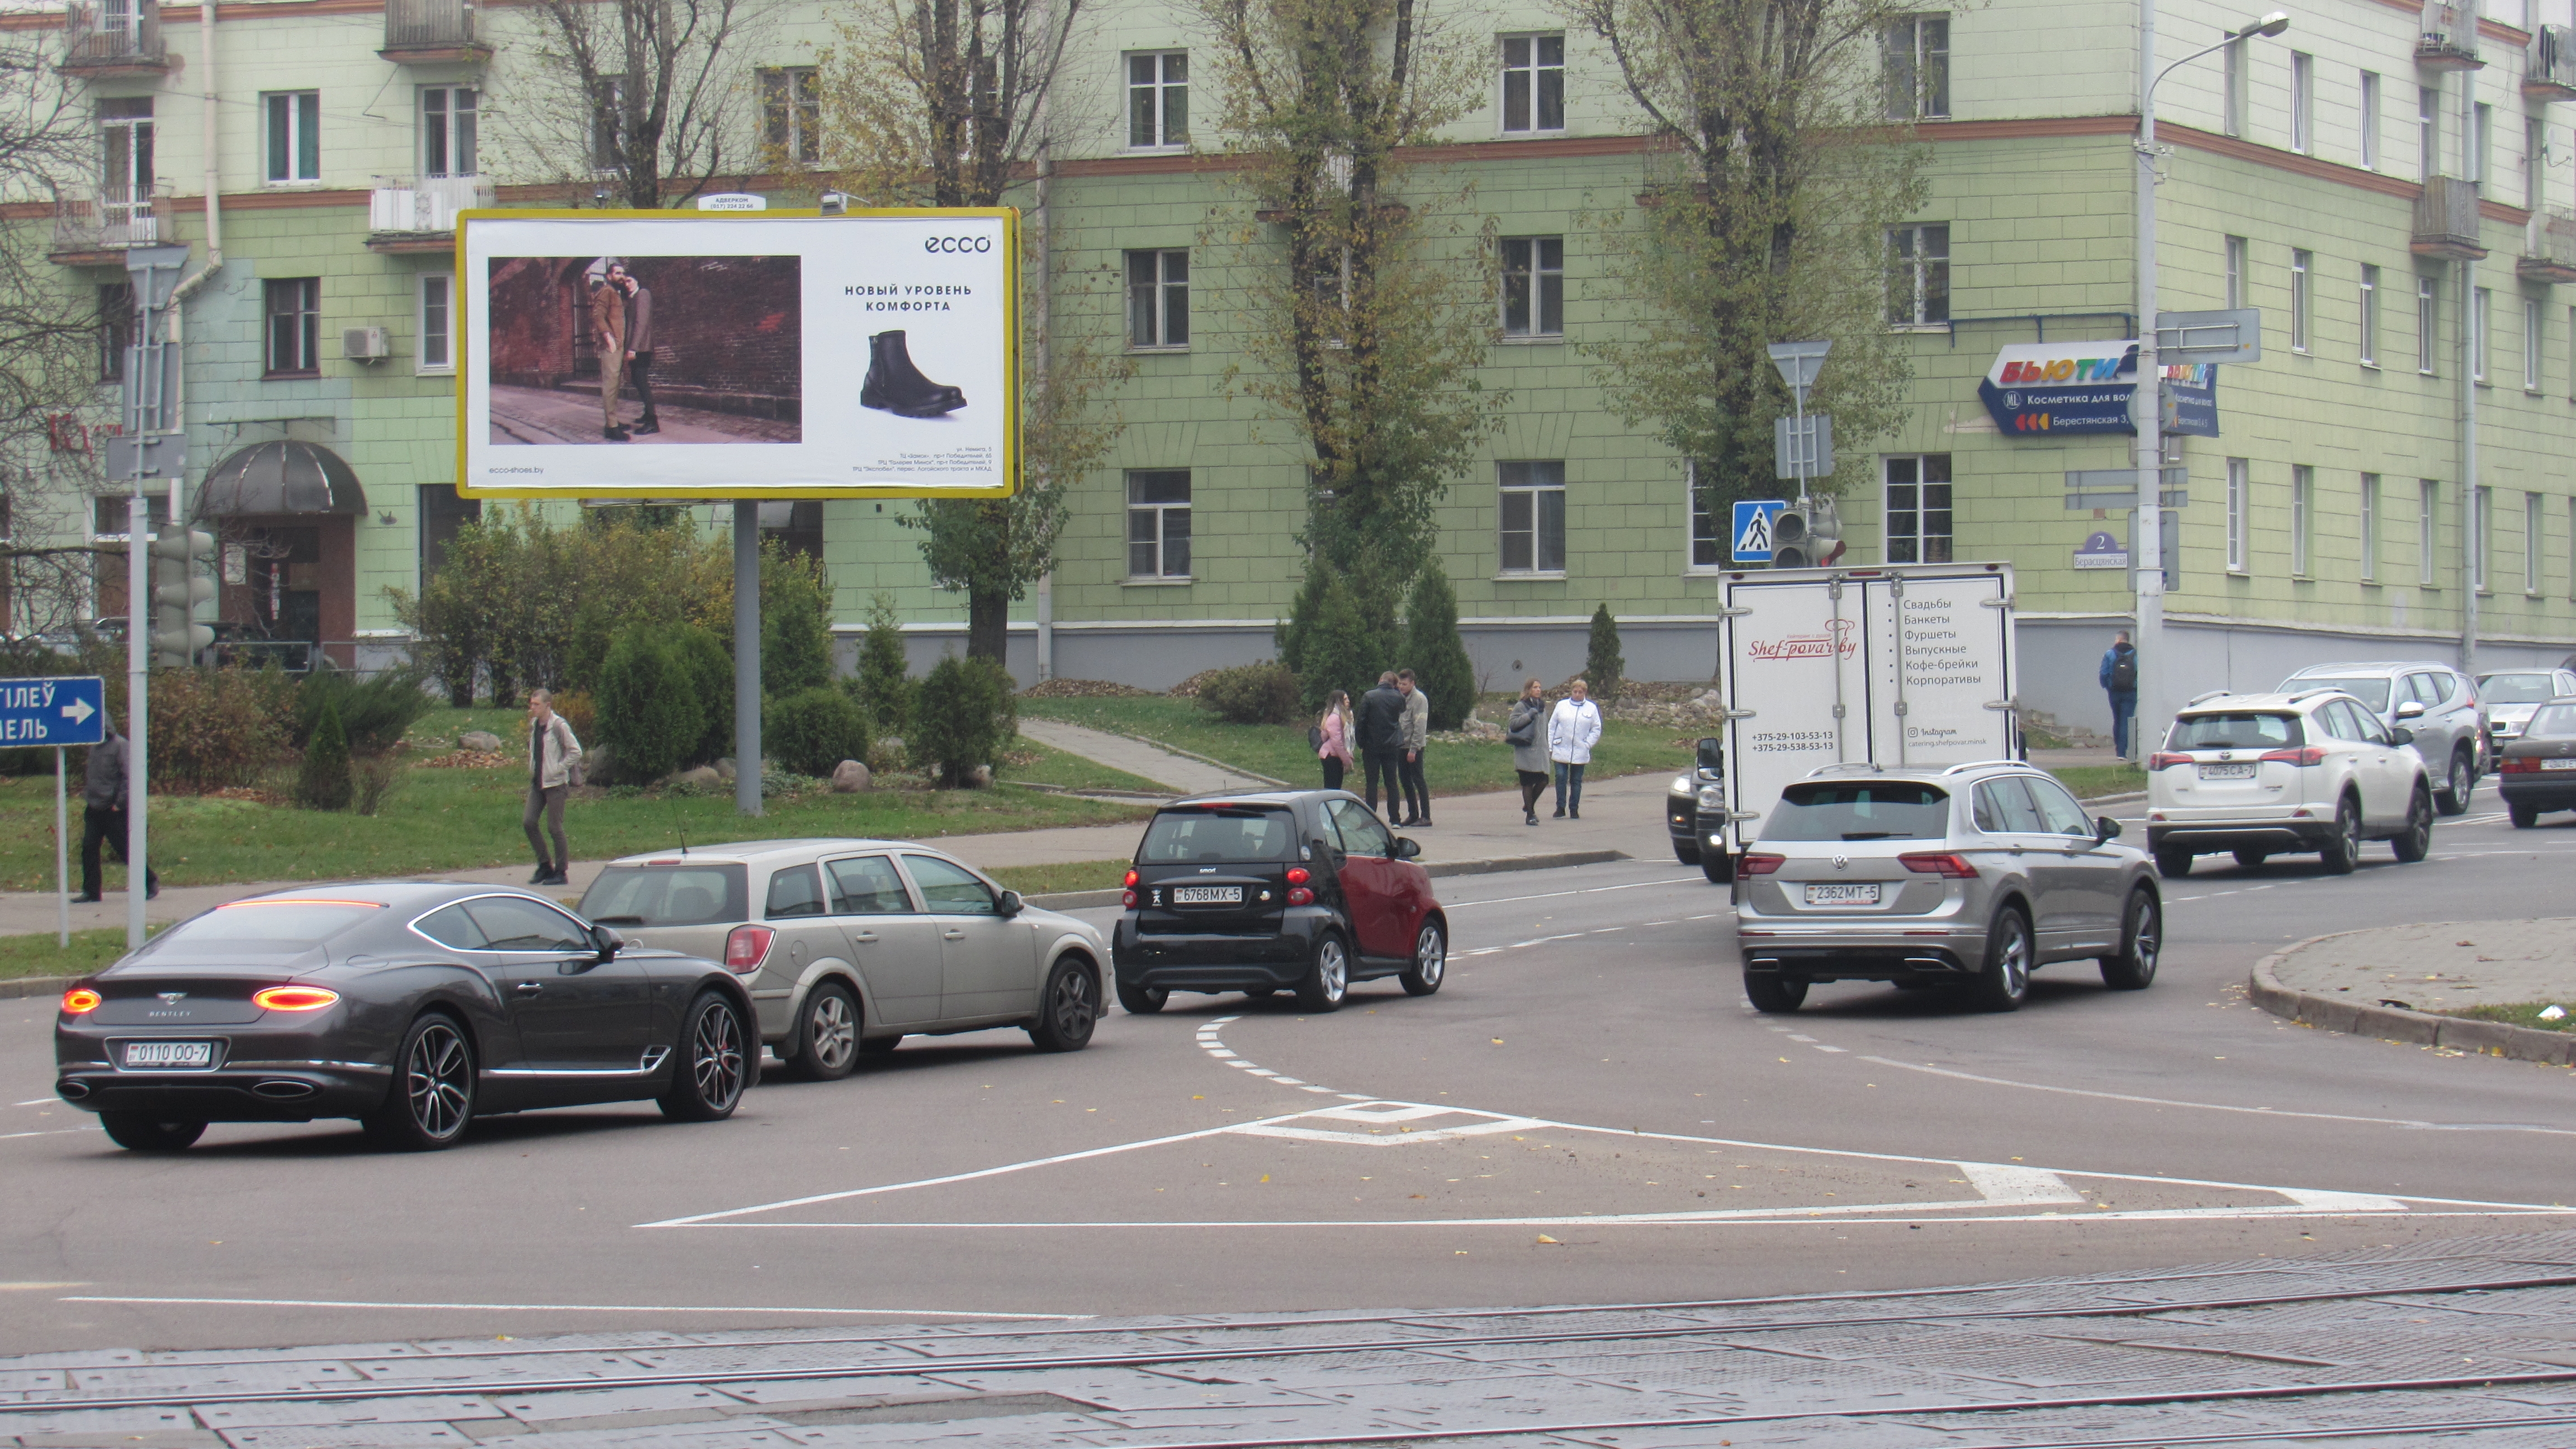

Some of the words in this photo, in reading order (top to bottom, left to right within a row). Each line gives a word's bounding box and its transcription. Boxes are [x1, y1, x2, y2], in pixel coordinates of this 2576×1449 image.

[925, 236, 991, 253] ecco
[845, 283, 898, 295] НОВЫЙ
[905, 285, 972, 295] УРОВЕНЬ
[866, 301, 951, 311] КОМФОРТА
[2000, 358, 2120, 382] БЬЮТИ
[2027, 395, 2089, 404] Косметика
[2091, 394, 2110, 403] для
[2053, 416, 2118, 427] Берестянская
[2096, 535, 2105, 550] 2
[2075, 557, 2127, 568] Берасцянская
[1903, 599, 1952, 610] Свадьбы
[1904, 615, 1950, 624] Банкеты
[1905, 630, 1956, 642] Фуршеты
[1748, 637, 1857, 661] Shef-povarby
[1905, 645, 1967, 656] Выпускные
[1906, 659, 1978, 671] Кофе-брейки
[1906, 676, 1981, 687] Корпоративы
[1752, 731, 1833, 741] +375-29-103-53-13
[1920, 728, 1957, 738] Instagram
[1753, 742, 1834, 752] +375-29-538-53-13
[1908, 738, 1987, 747] catering.shefpovar.minsk
